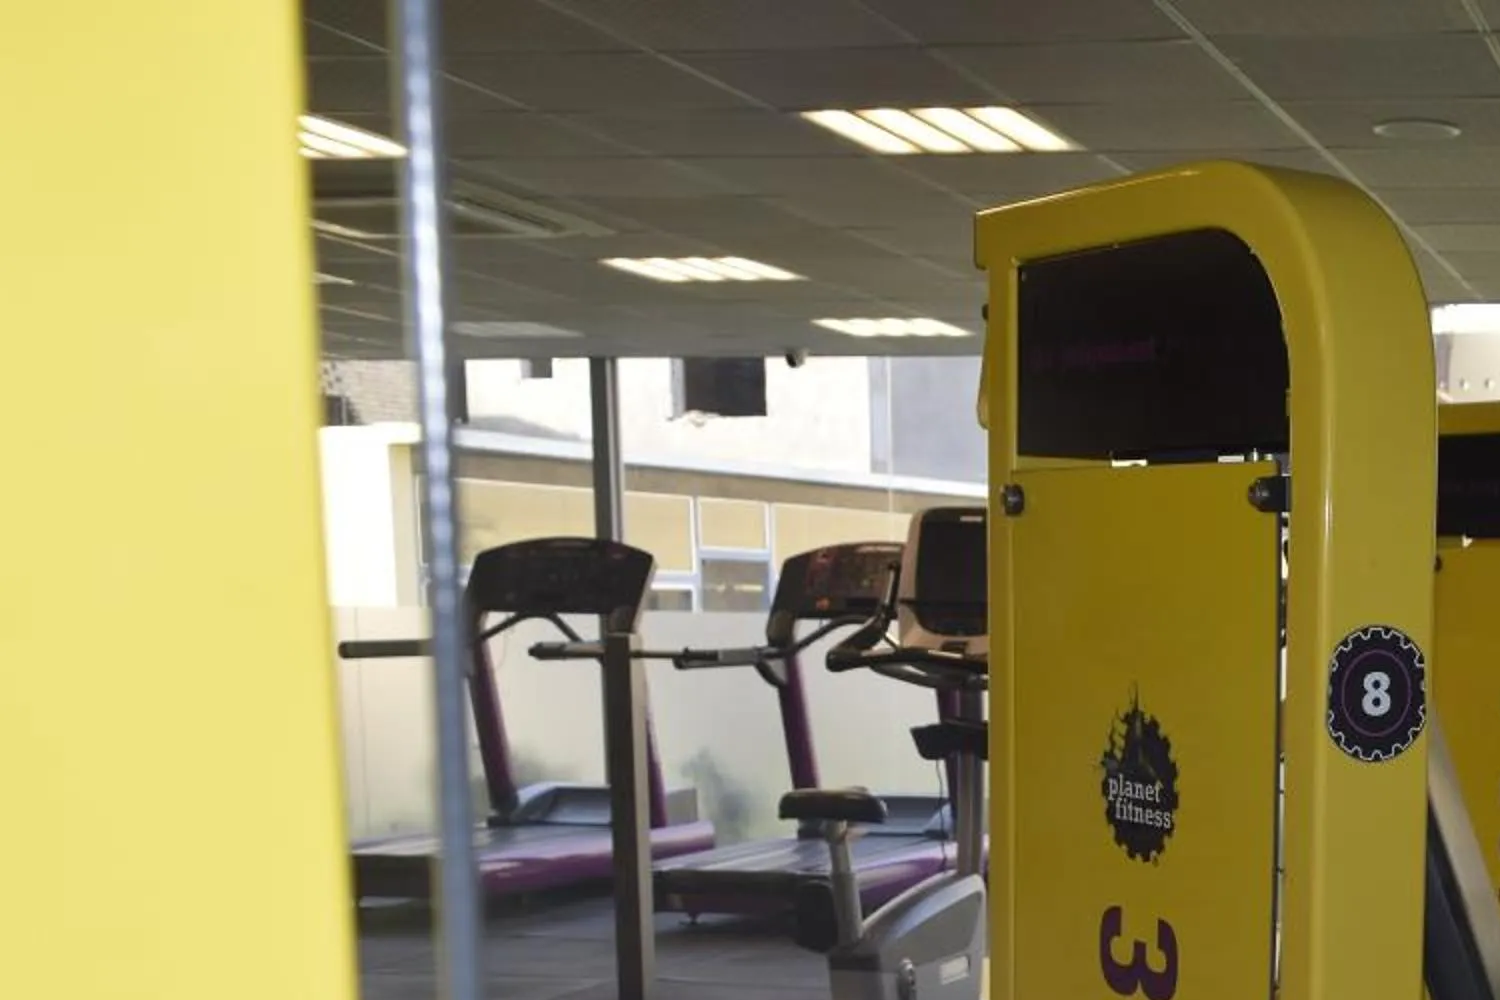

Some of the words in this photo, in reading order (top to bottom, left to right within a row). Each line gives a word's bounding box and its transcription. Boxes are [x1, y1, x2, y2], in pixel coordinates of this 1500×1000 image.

[1362, 671, 1391, 717] 8
[1108, 772, 1164, 803] planet
[1115, 796, 1171, 829] fitness
